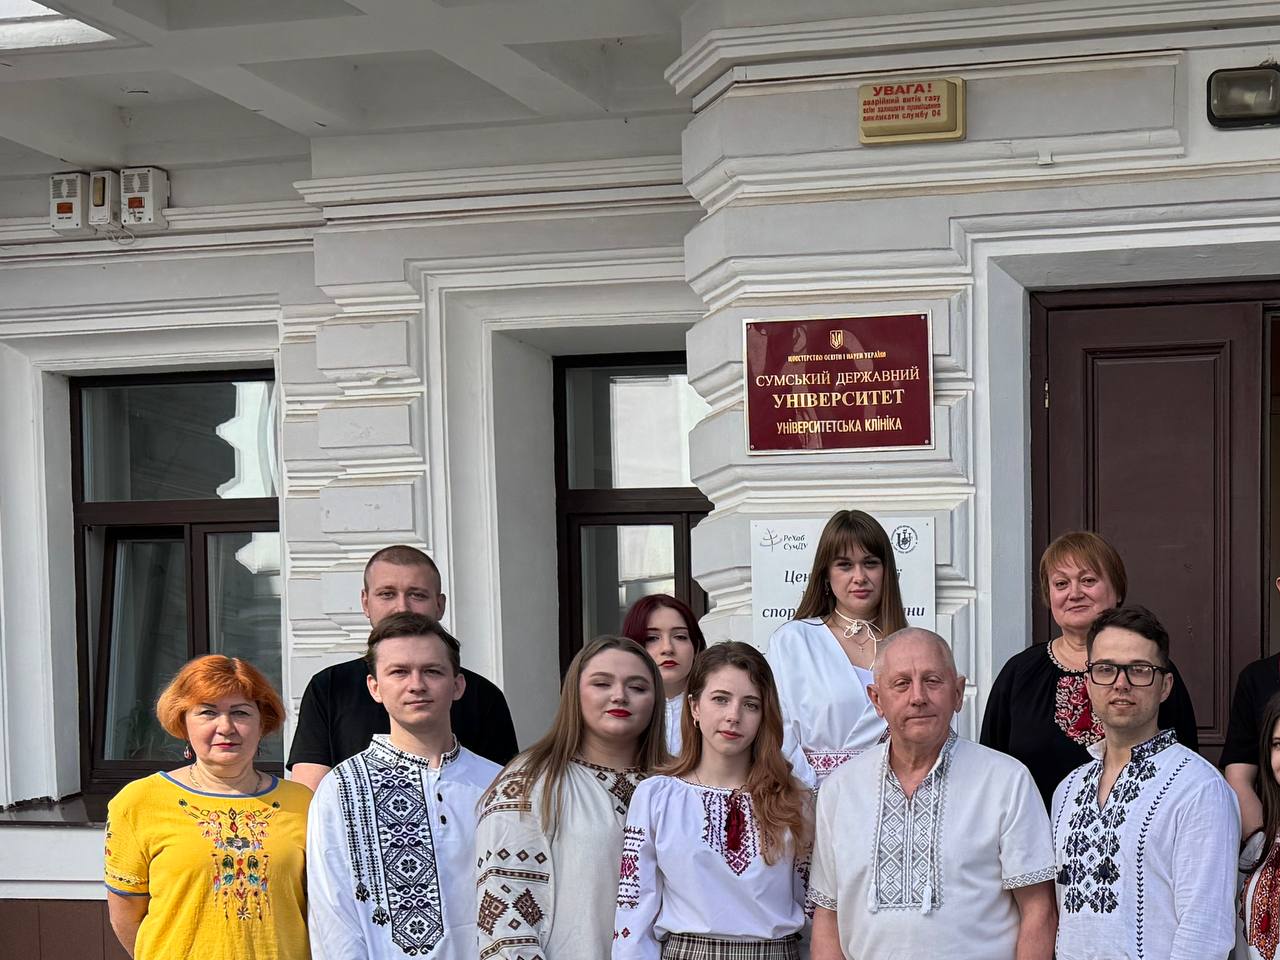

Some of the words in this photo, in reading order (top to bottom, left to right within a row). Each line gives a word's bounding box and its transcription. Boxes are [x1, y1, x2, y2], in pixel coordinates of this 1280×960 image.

[873, 83, 933, 97] УВАГА!
[755, 370, 831, 387] СУМСЬКИЙ
[835, 366, 920, 386] ДЕРЖАВНИЙ
[772, 388, 905, 409] УНІВЕРСИТЕТ
